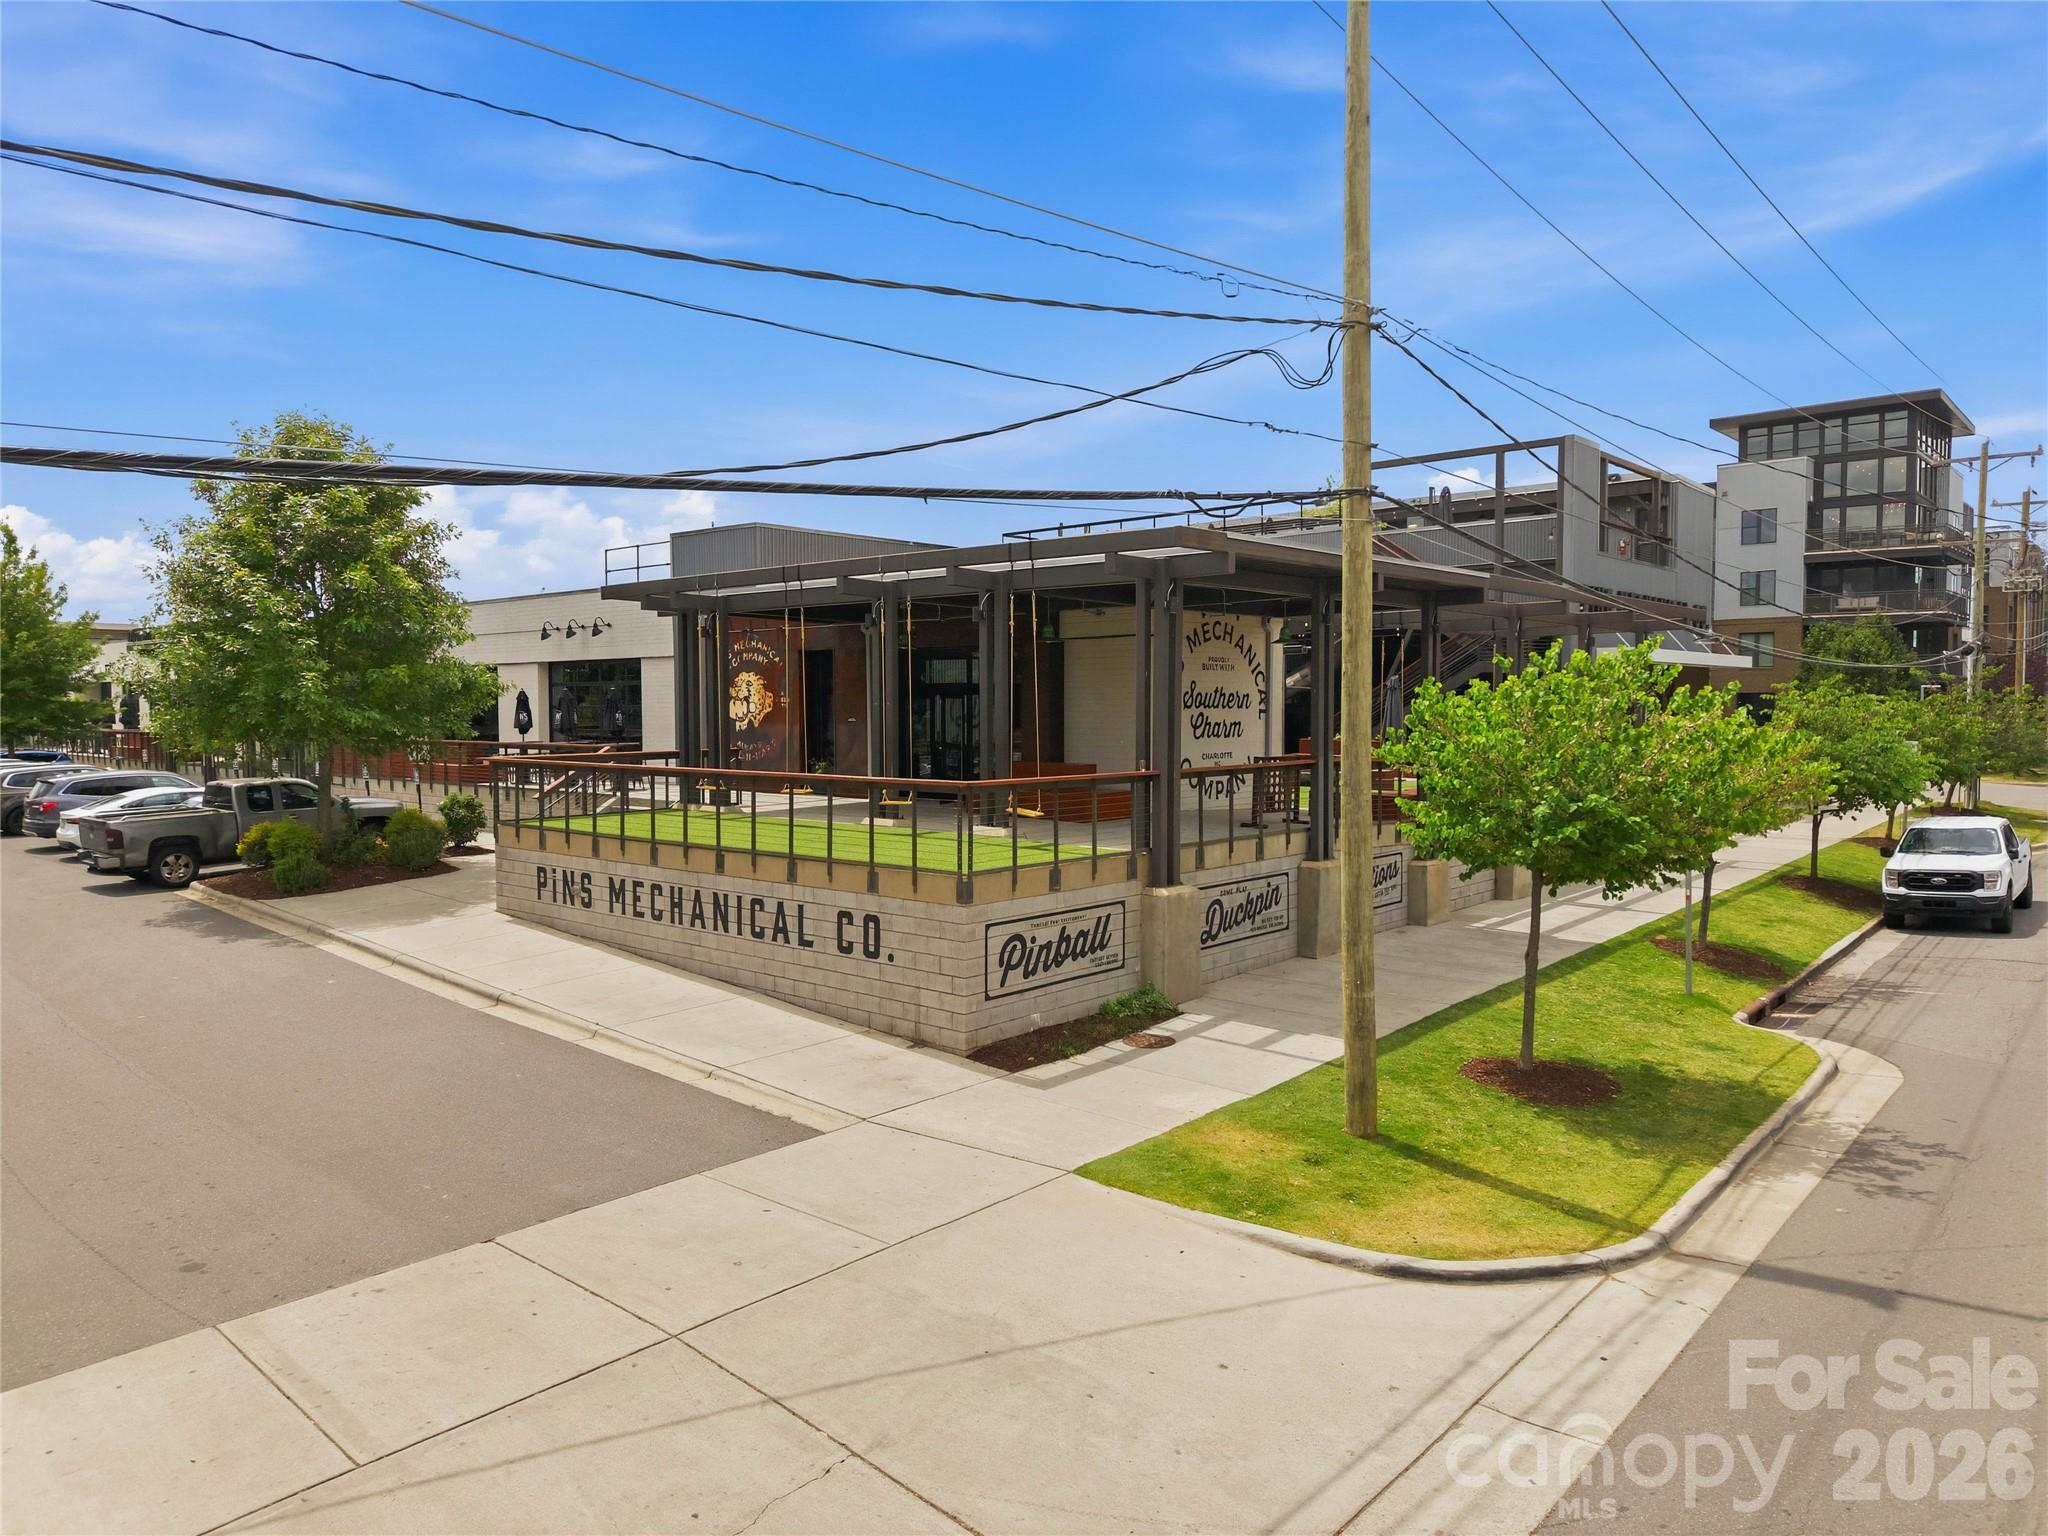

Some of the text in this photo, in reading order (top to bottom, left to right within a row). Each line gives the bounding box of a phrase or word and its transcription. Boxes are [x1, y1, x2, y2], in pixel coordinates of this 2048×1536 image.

[733, 639, 785, 670] MECHANICA
[1186, 620, 1267, 720] MECHANICAL
[1202, 662, 1235, 672] BUILT WITH
[1183, 680, 1251, 710] Southern
[1190, 711, 1244, 740] Charm
[1201, 751, 1233, 760] CHARLOTTE
[608, 877, 814, 949] MECHANICAL
[836, 909, 895, 963] CO.
[1200, 881, 1282, 944] Duckpin
[998, 913, 1112, 988] Pinball
